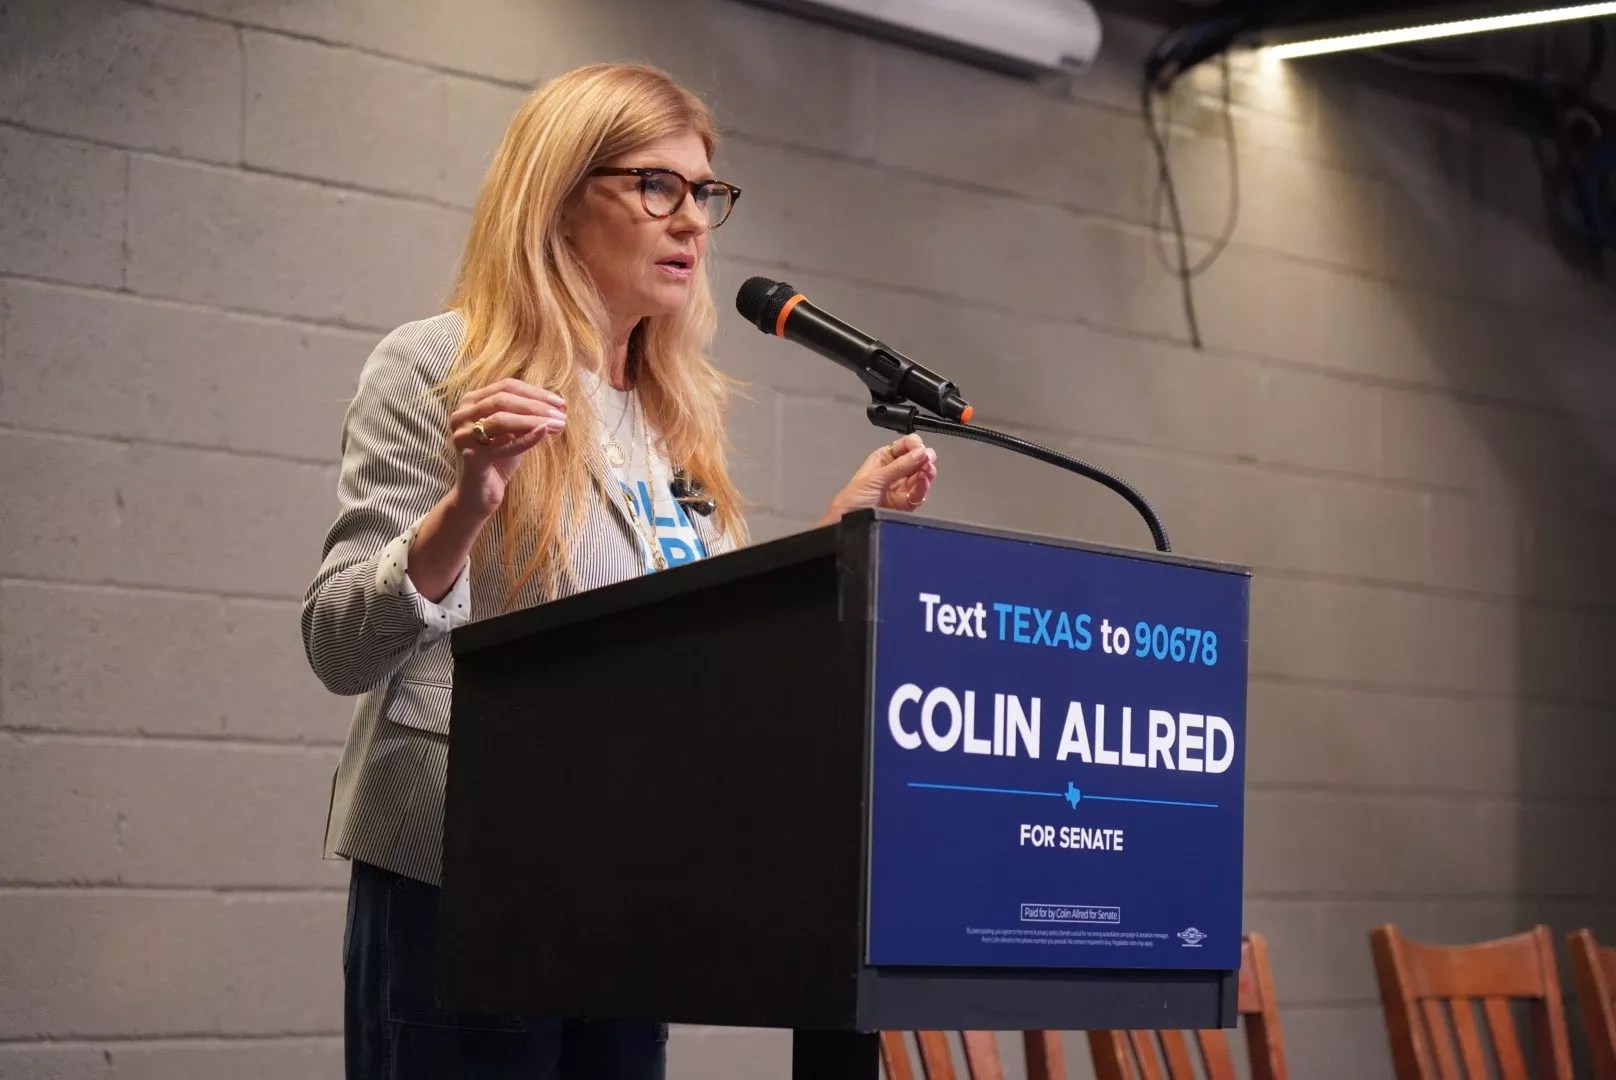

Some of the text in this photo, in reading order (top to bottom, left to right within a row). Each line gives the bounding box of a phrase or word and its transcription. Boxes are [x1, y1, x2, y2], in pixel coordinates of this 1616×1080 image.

[918, 591, 1218, 667] Text TEXAS to 90678
[887, 682, 1235, 774] COLIN ALLRED
[1019, 823, 1124, 852] FOR SENATE
[1024, 907, 1118, 920] Paid for by Colin Allred for Senate
